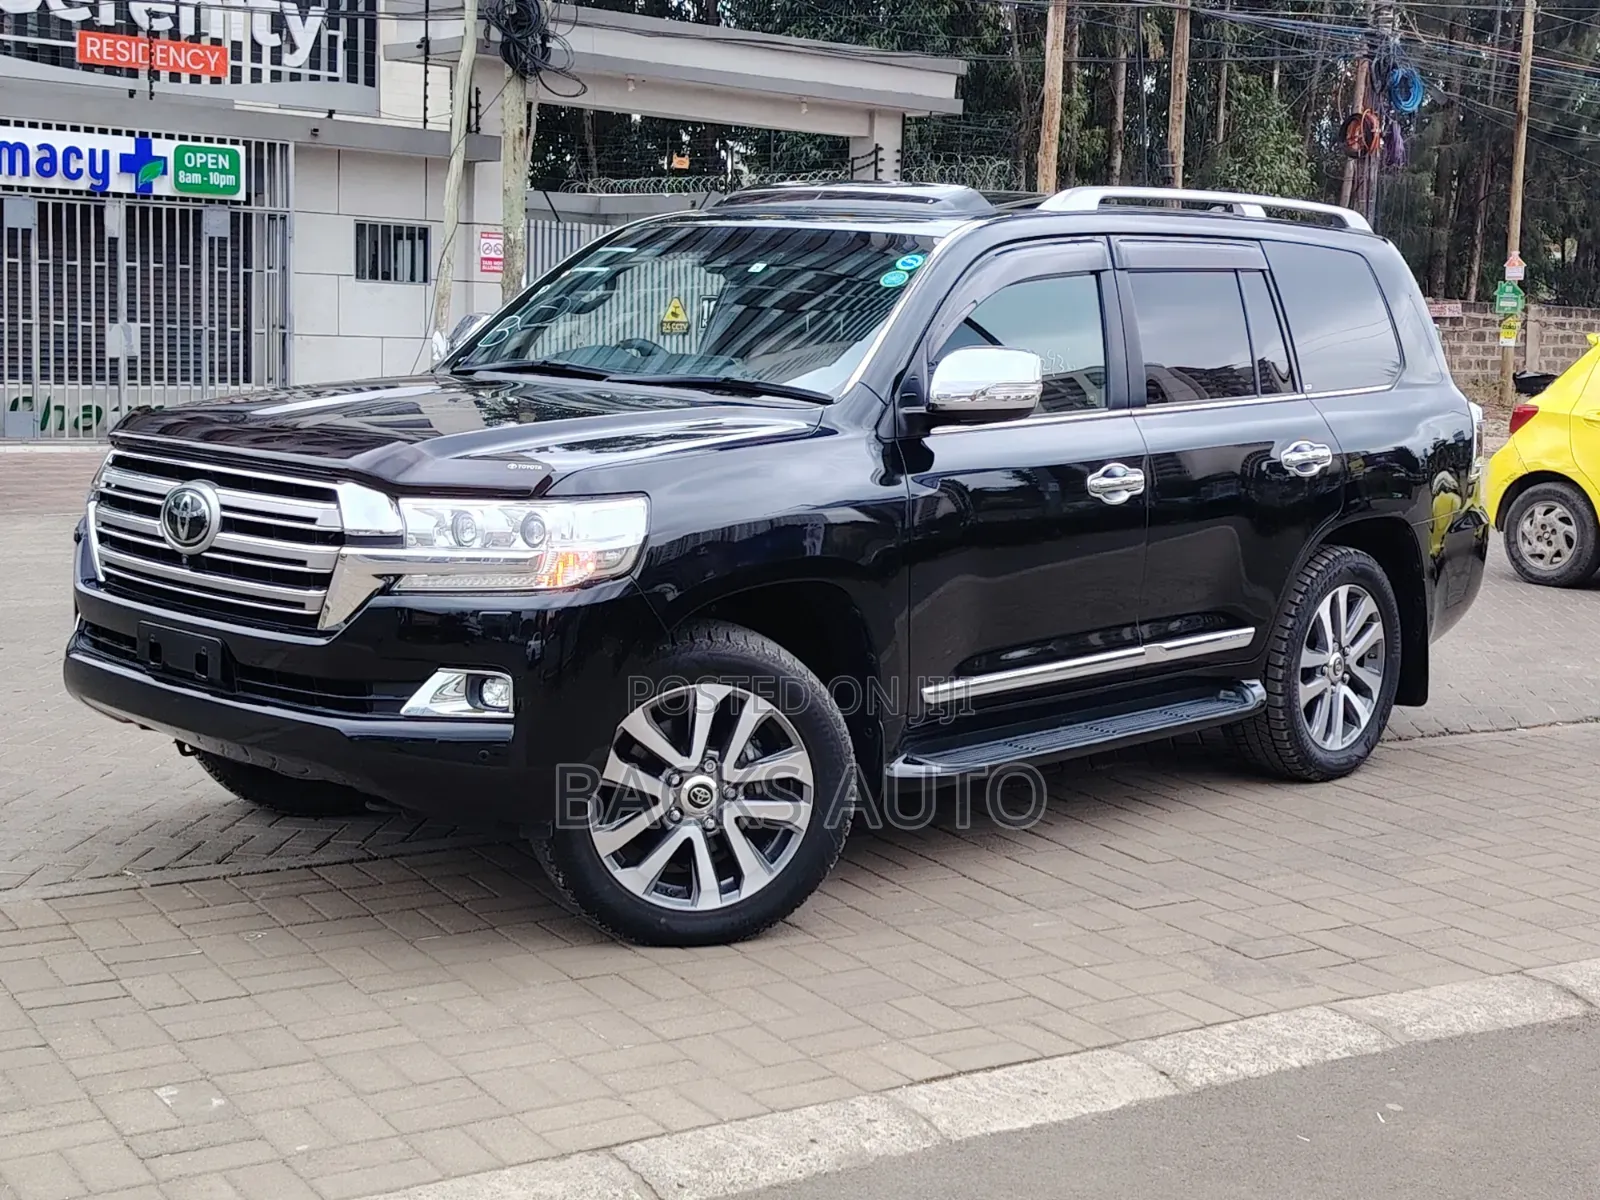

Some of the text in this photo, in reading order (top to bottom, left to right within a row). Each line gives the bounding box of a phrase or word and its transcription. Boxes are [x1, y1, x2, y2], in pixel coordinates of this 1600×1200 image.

[0, 0, 327, 68] enity
[86, 36, 220, 72] RESIDENCY
[184, 152, 230, 170] OPEN
[178, 170, 202, 185] 8am
[208, 171, 236, 188] 10pm
